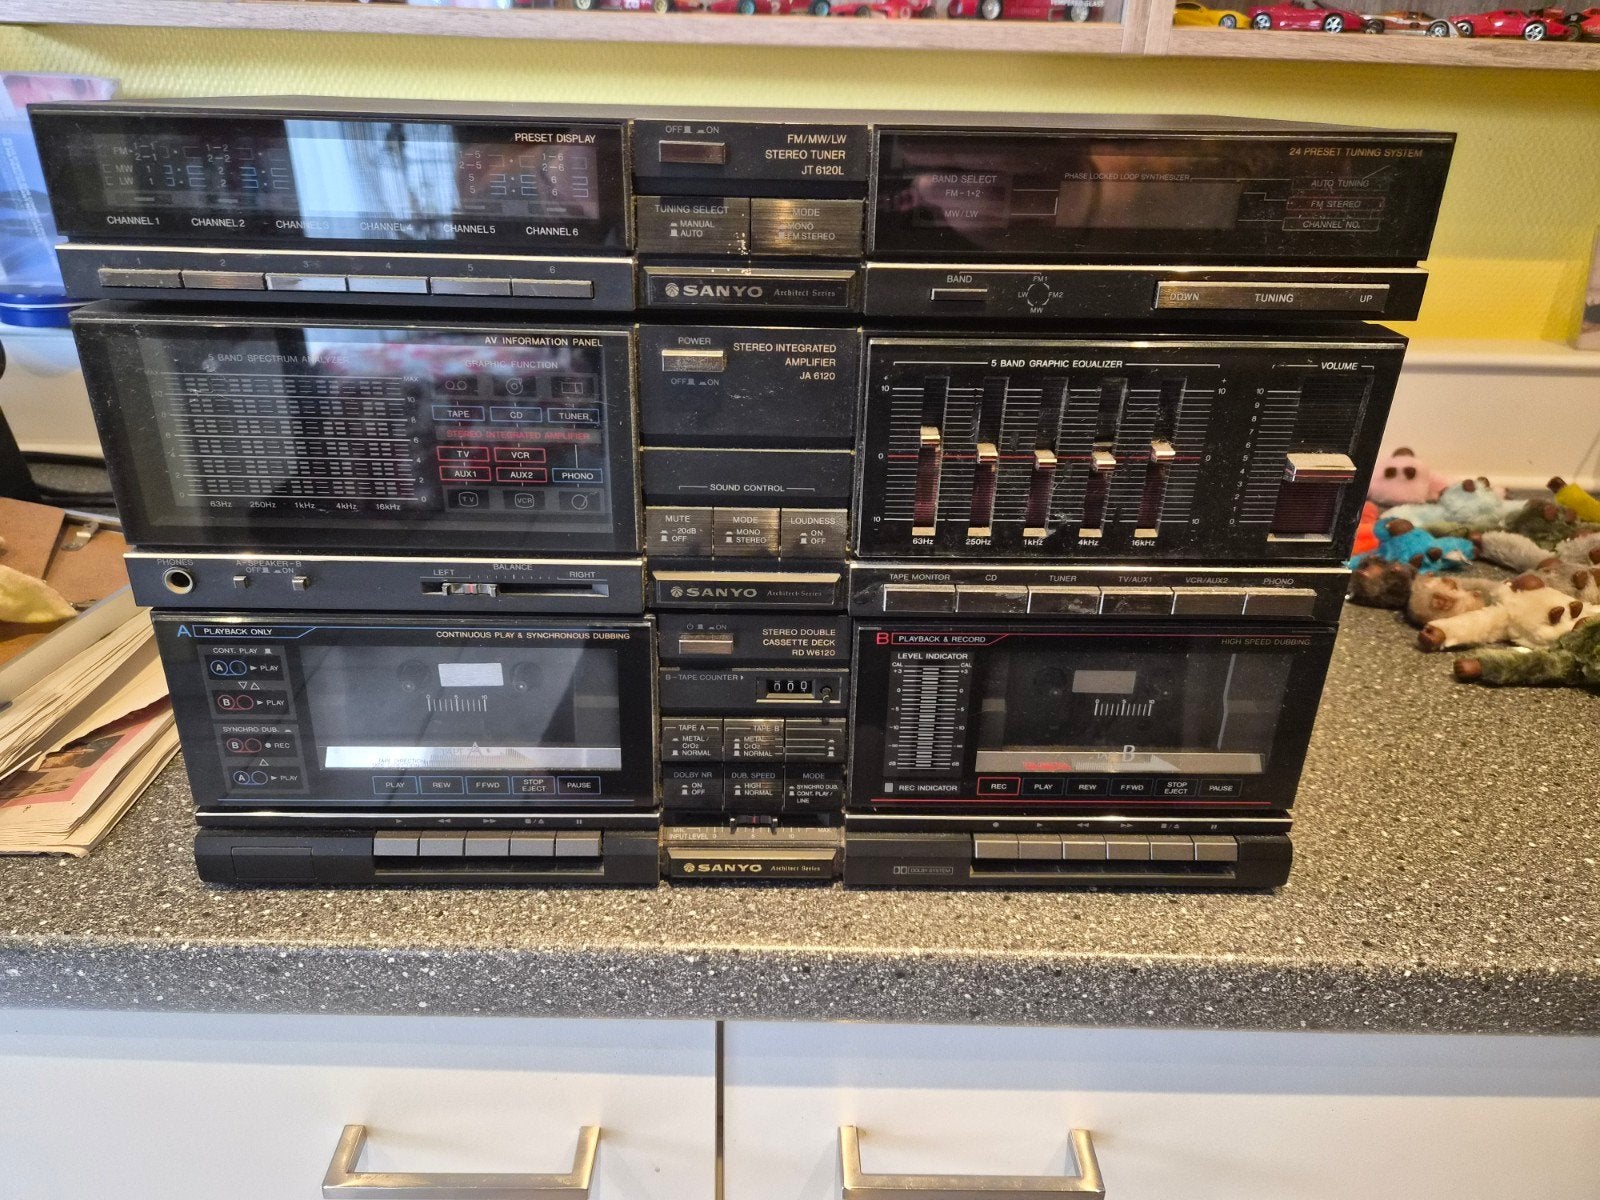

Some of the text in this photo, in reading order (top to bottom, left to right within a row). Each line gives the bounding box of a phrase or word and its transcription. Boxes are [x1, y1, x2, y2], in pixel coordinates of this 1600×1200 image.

[515, 133, 596, 144] PRESET DISPLAY
[788, 135, 846, 144] FM/MW/LW
[765, 151, 845, 159] STEREO TUNER
[1290, 148, 1422, 158] 24 PRESET TUNING SYSTEM
[801, 166, 844, 175] JT 6120L
[932, 174, 998, 184] BAND SELECT
[1311, 179, 1369, 188] AUTO TUNING
[655, 205, 729, 214] TUNING SELECT
[793, 209, 820, 217] MODE
[107, 217, 154, 225] CHANNEL
[191, 218, 238, 227] CHANNEL
[443, 225, 489, 233] CHANNEL
[526, 227, 578, 236] CHANNEL 6
[946, 275, 972, 283] BAND
[683, 285, 762, 297] SANYO
[1255, 294, 1294, 302] TUNING
[1360, 294, 1372, 302] UP
[502, 337, 568, 346] INFORMATION
[734, 344, 836, 353] STEREO INTEGRATED
[511, 361, 558, 369] FUNCTION
[1000, 360, 1025, 368] BAND
[1029, 360, 1069, 368] GRAPHIC
[1073, 360, 1122, 369] EQUALIZER
[800, 372, 835, 380] JA 6120
[486, 431, 540, 439] INTEGRATED
[545, 432, 590, 440] AMPLIFIER
[966, 538, 991, 546] 250Hz
[1024, 538, 1043, 546] 1kHz
[1132, 539, 1156, 547] 16kHz
[493, 563, 533, 571] BALANCE
[570, 571, 596, 579] RIGHT
[911, 573, 950, 581] MONITOR
[687, 588, 757, 598] SANYO
[177, 624, 192, 637] A
[251, 628, 272, 636] ONLY
[593, 632, 630, 640] DUBBING
[876, 633, 889, 644] B
[1122, 744, 1136, 761] B
[698, 864, 762, 872] SANYO
